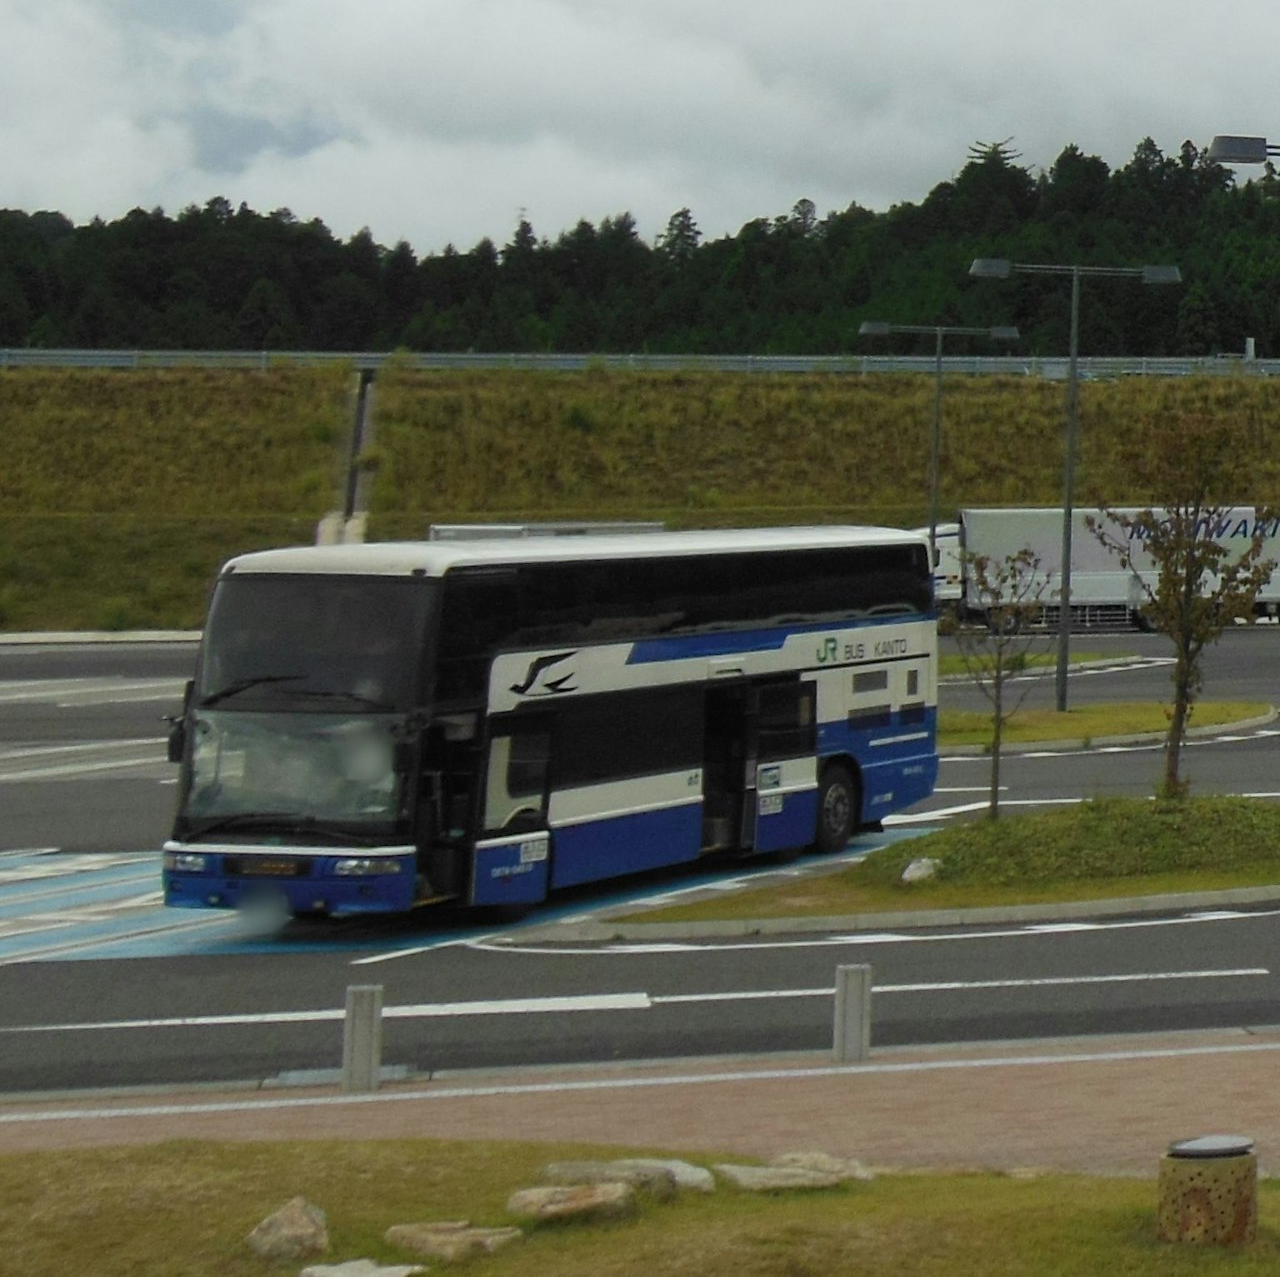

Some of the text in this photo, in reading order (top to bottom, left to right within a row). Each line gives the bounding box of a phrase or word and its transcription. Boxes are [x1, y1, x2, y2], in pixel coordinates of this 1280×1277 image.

[816, 637, 907, 662] JR BUS KANTO
